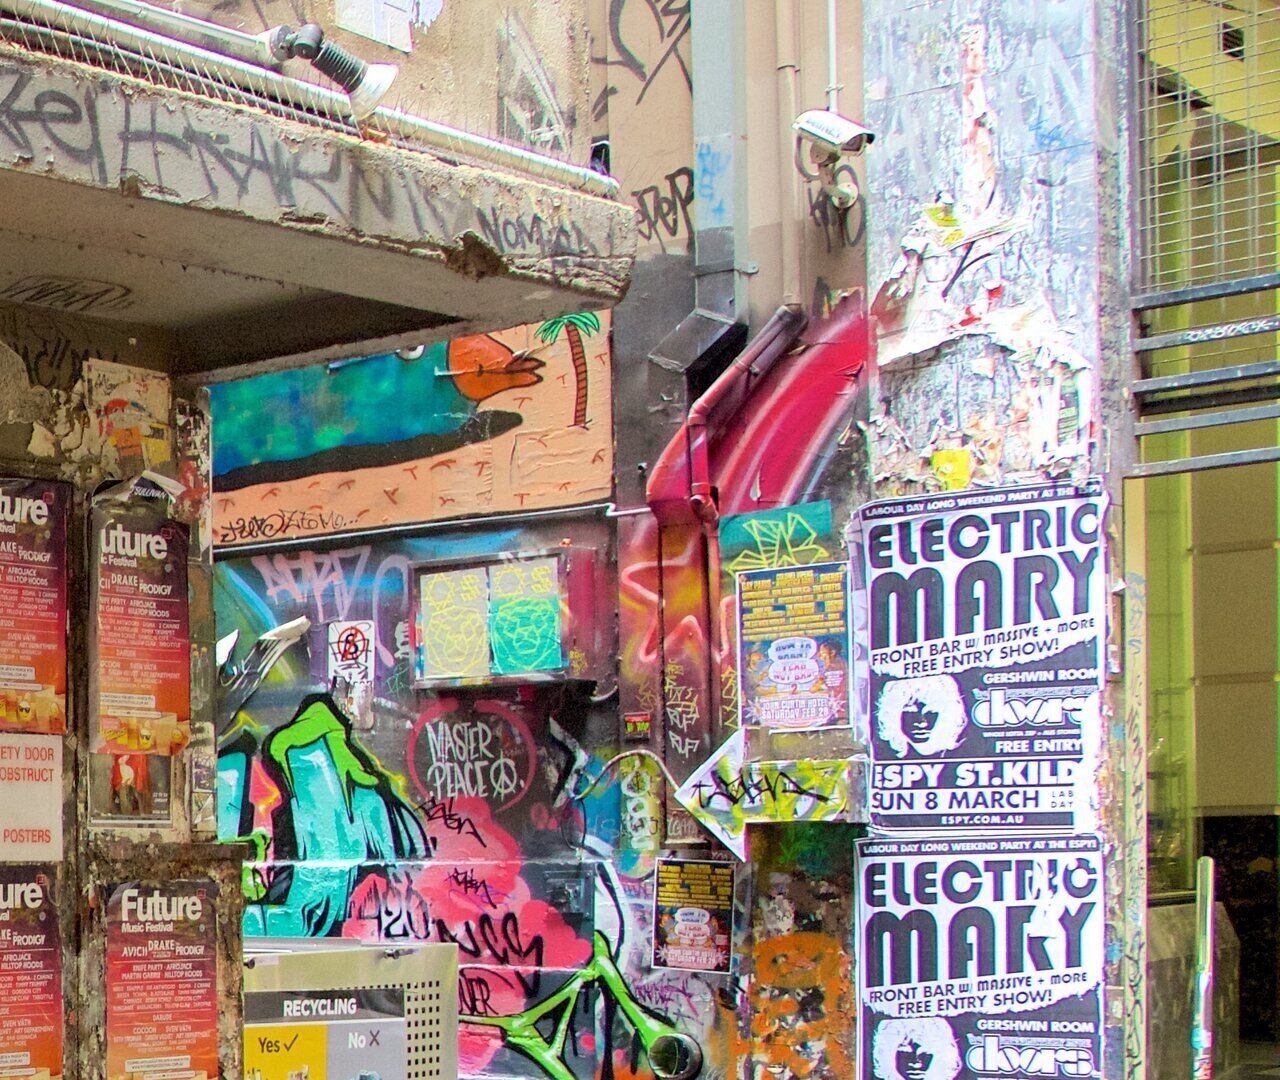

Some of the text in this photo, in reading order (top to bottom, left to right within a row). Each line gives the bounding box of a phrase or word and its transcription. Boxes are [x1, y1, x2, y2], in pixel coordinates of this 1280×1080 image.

[869, 503, 1100, 569] ELECTRIC
[18, 550, 50, 563] PRODIGY
[111, 573, 138, 587] DRAKE
[871, 549, 1099, 650] MARY
[872, 618, 1095, 665] FRONT BAR MASSIVE MORE
[904, 638, 1059, 675] FREE ENTRY SHOW!
[762, 708, 800, 720] SATURDAY
[803, 708, 816, 718] FEB
[425, 721, 494, 762] MASTER
[25, 746, 54, 761] DOOR
[0, 766, 54, 782] OBSTRUCT
[429, 759, 488, 798] PEACE
[874, 763, 944, 788] ESPY
[872, 790, 1039, 810] SUN 8 MARCH
[941, 814, 1024, 825] ESPY.COM.AU
[3, 829, 51, 843] POSTERS
[864, 839, 1097, 854] LABOUR DAY LONG WEEKEND PARTY AT THE ESPY!
[122, 889, 202, 922] Future
[122, 922, 173, 933] Music Festival
[13, 934, 45, 946] PRODIGY
[122, 940, 204, 957] AVICII DRAKE PRODIGY
[865, 902, 1096, 988] MARY
[870, 972, 1087, 1003] FRONT BAR MASSIVE MORE
[283, 998, 357, 1017] RECYCLING
[898, 989, 1052, 1015] FREE ENTRY SHOW!
[977, 1019, 1094, 1032] GERSHWIN ROOM
[258, 1037, 280, 1054] Yes
[348, 1032, 366, 1049] No
